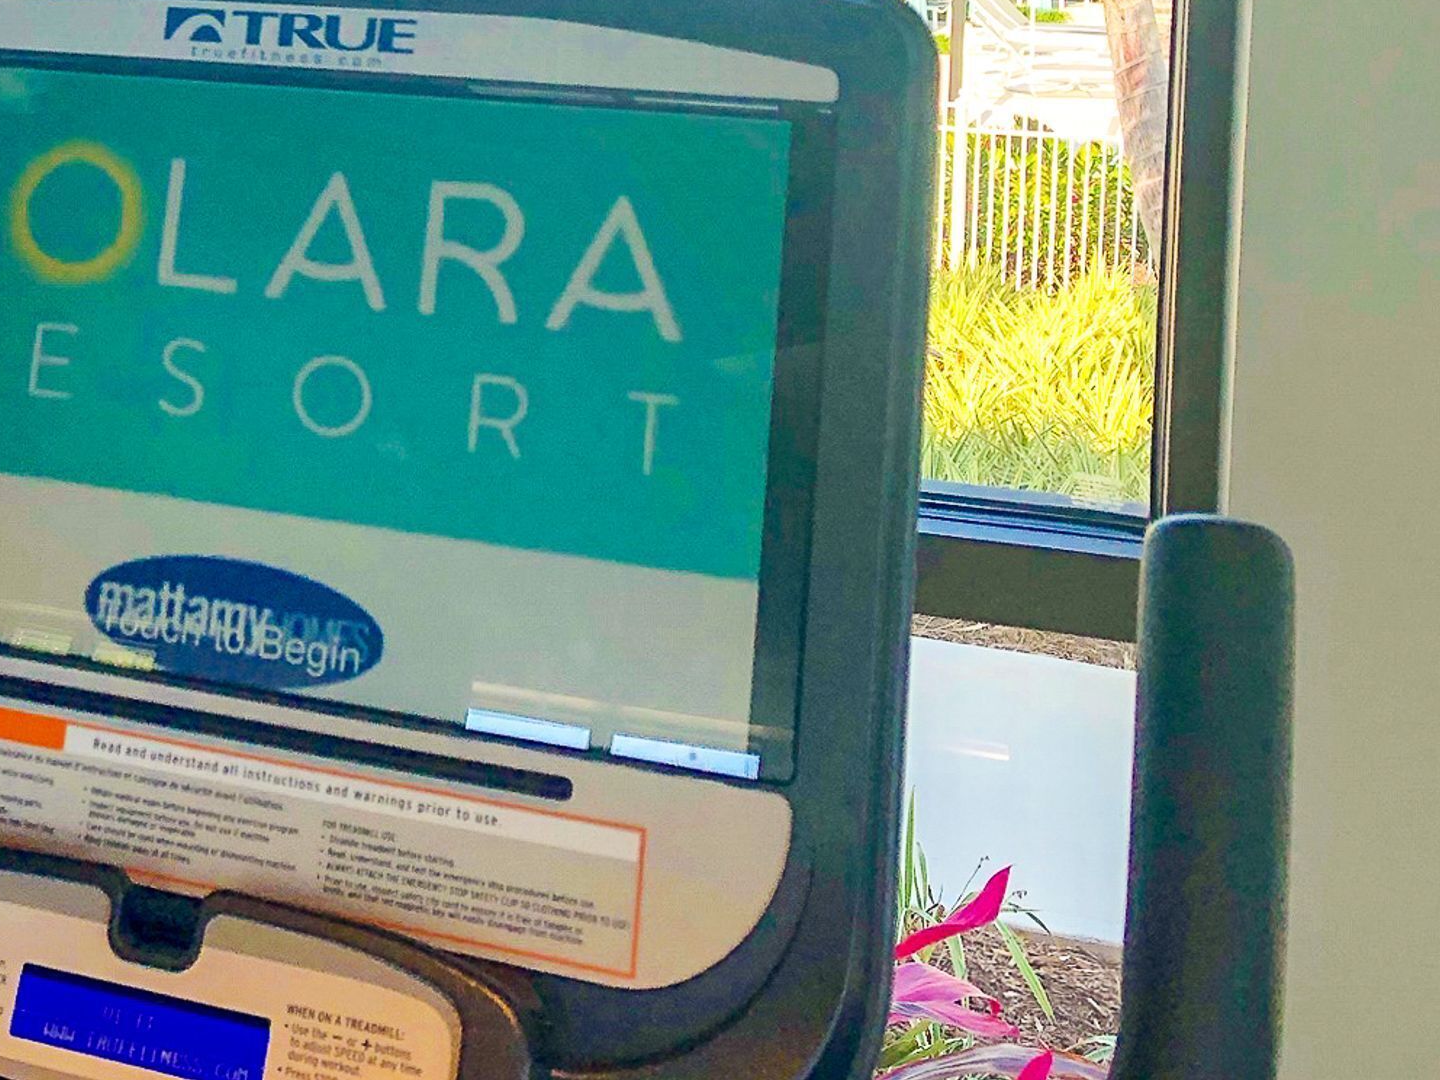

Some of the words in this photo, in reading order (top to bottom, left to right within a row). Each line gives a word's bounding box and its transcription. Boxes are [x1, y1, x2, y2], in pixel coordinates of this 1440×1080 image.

[232, 10, 417, 54] TRUE
[258, 623, 360, 678] Begin
[92, 738, 121, 754] Read
[125, 745, 146, 759] and
[150, 749, 218, 772] understand
[222, 763, 238, 775] all
[242, 766, 321, 792] instructions
[325, 783, 348, 798] and
[353, 788, 412, 812] warnings
[417, 801, 451, 819] prior
[455, 809, 471, 821] to
[287, 1004, 315, 1020] WHEN
[318, 1011, 332, 1025] ON
[335, 1014, 341, 1025] A
